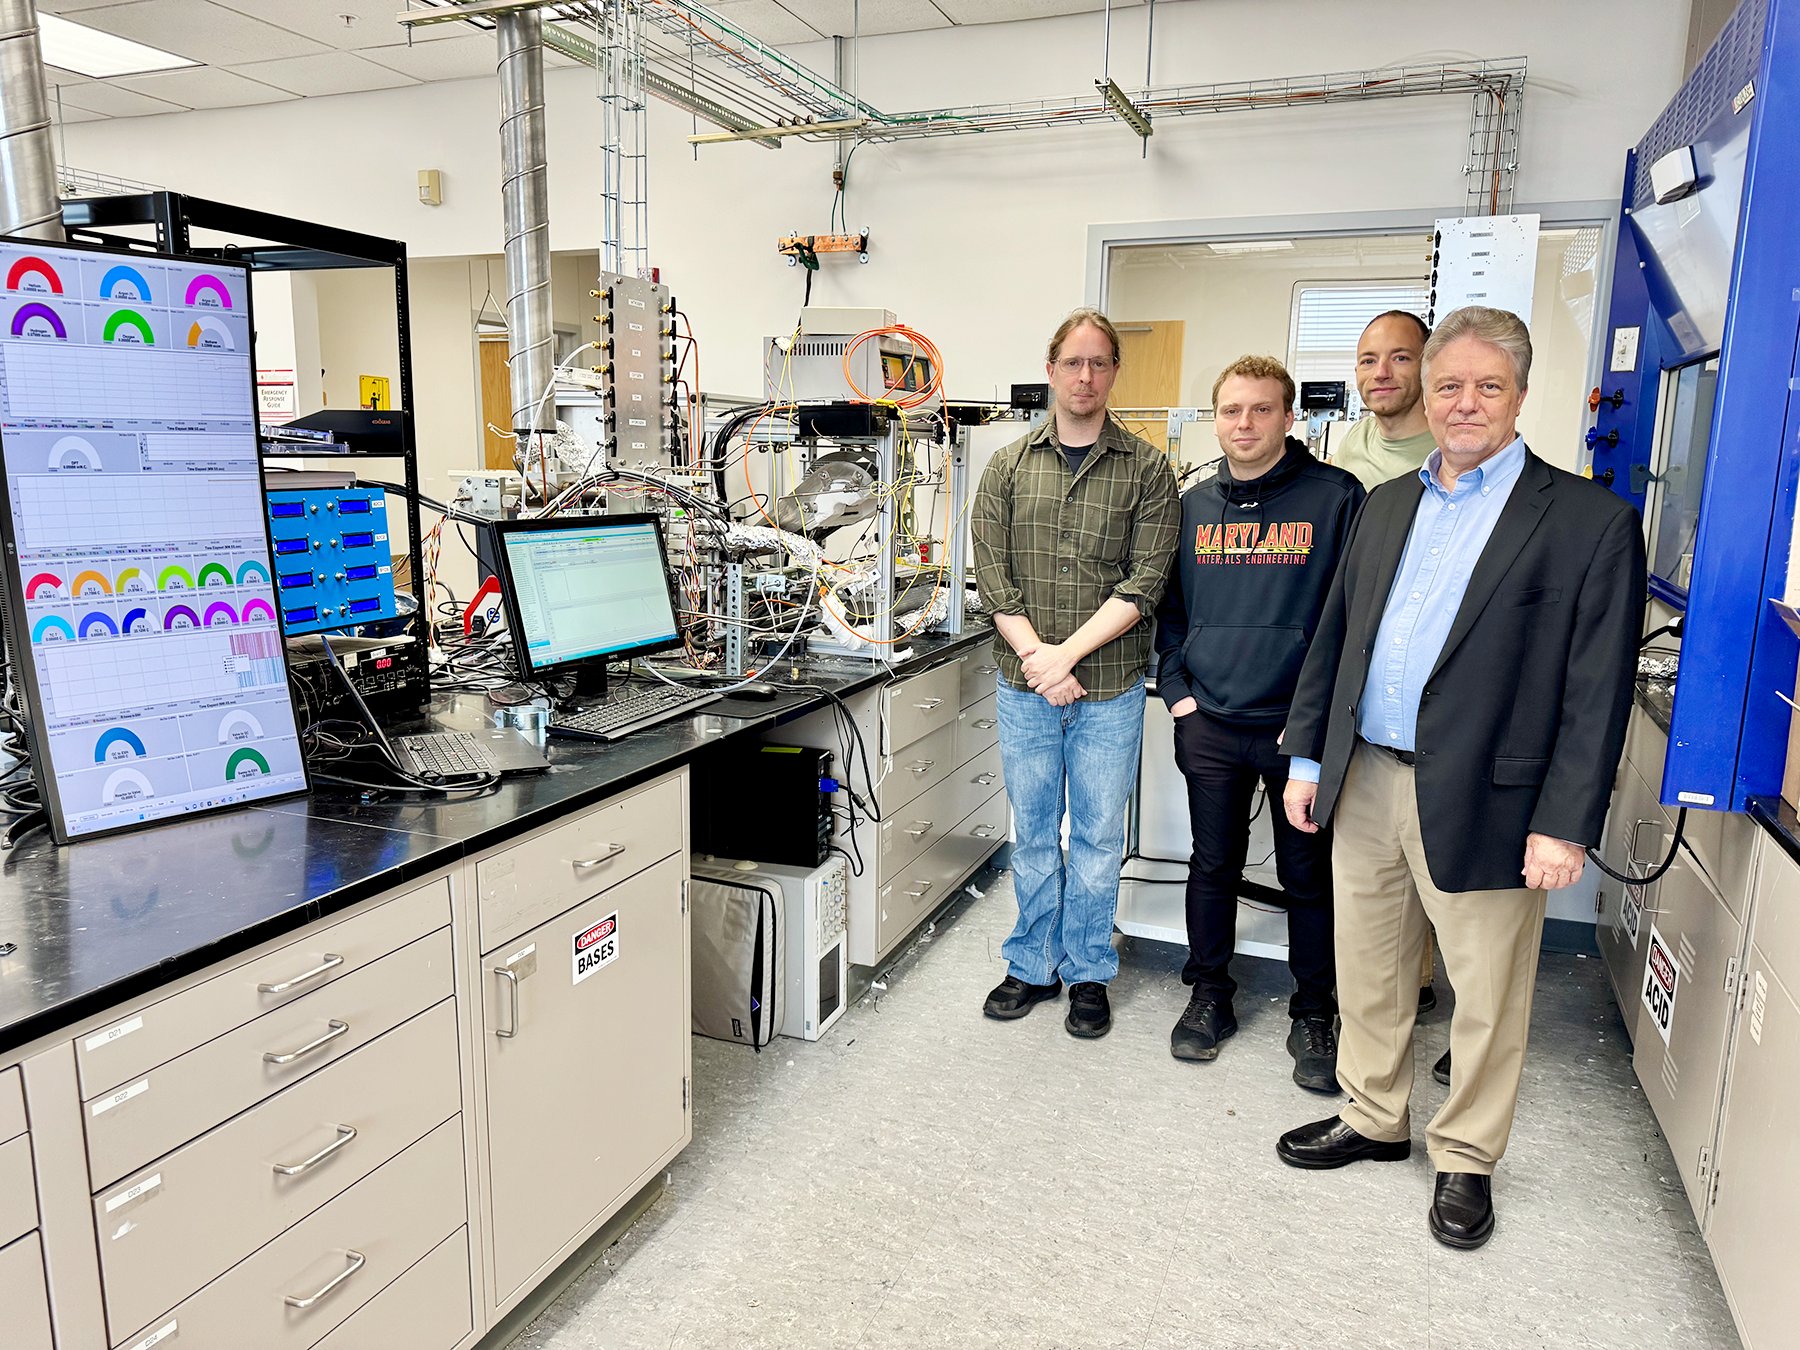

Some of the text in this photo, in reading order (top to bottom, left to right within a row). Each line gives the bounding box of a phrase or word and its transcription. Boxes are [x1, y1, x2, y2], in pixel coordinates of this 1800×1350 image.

[1195, 522, 1313, 548] MARYLAND
[1246, 553, 1307, 565] ENGINEERING
[1623, 895, 1638, 937] ACID
[580, 922, 612, 947] DANGER
[578, 940, 614, 975] BASES
[1651, 946, 1673, 990] DANGER
[1645, 974, 1669, 1029] ACID
[108, 1028, 122, 1039] D21
[114, 1091, 128, 1103] D22
[127, 1186, 141, 1199] D23
[144, 1334, 159, 1348] D24
